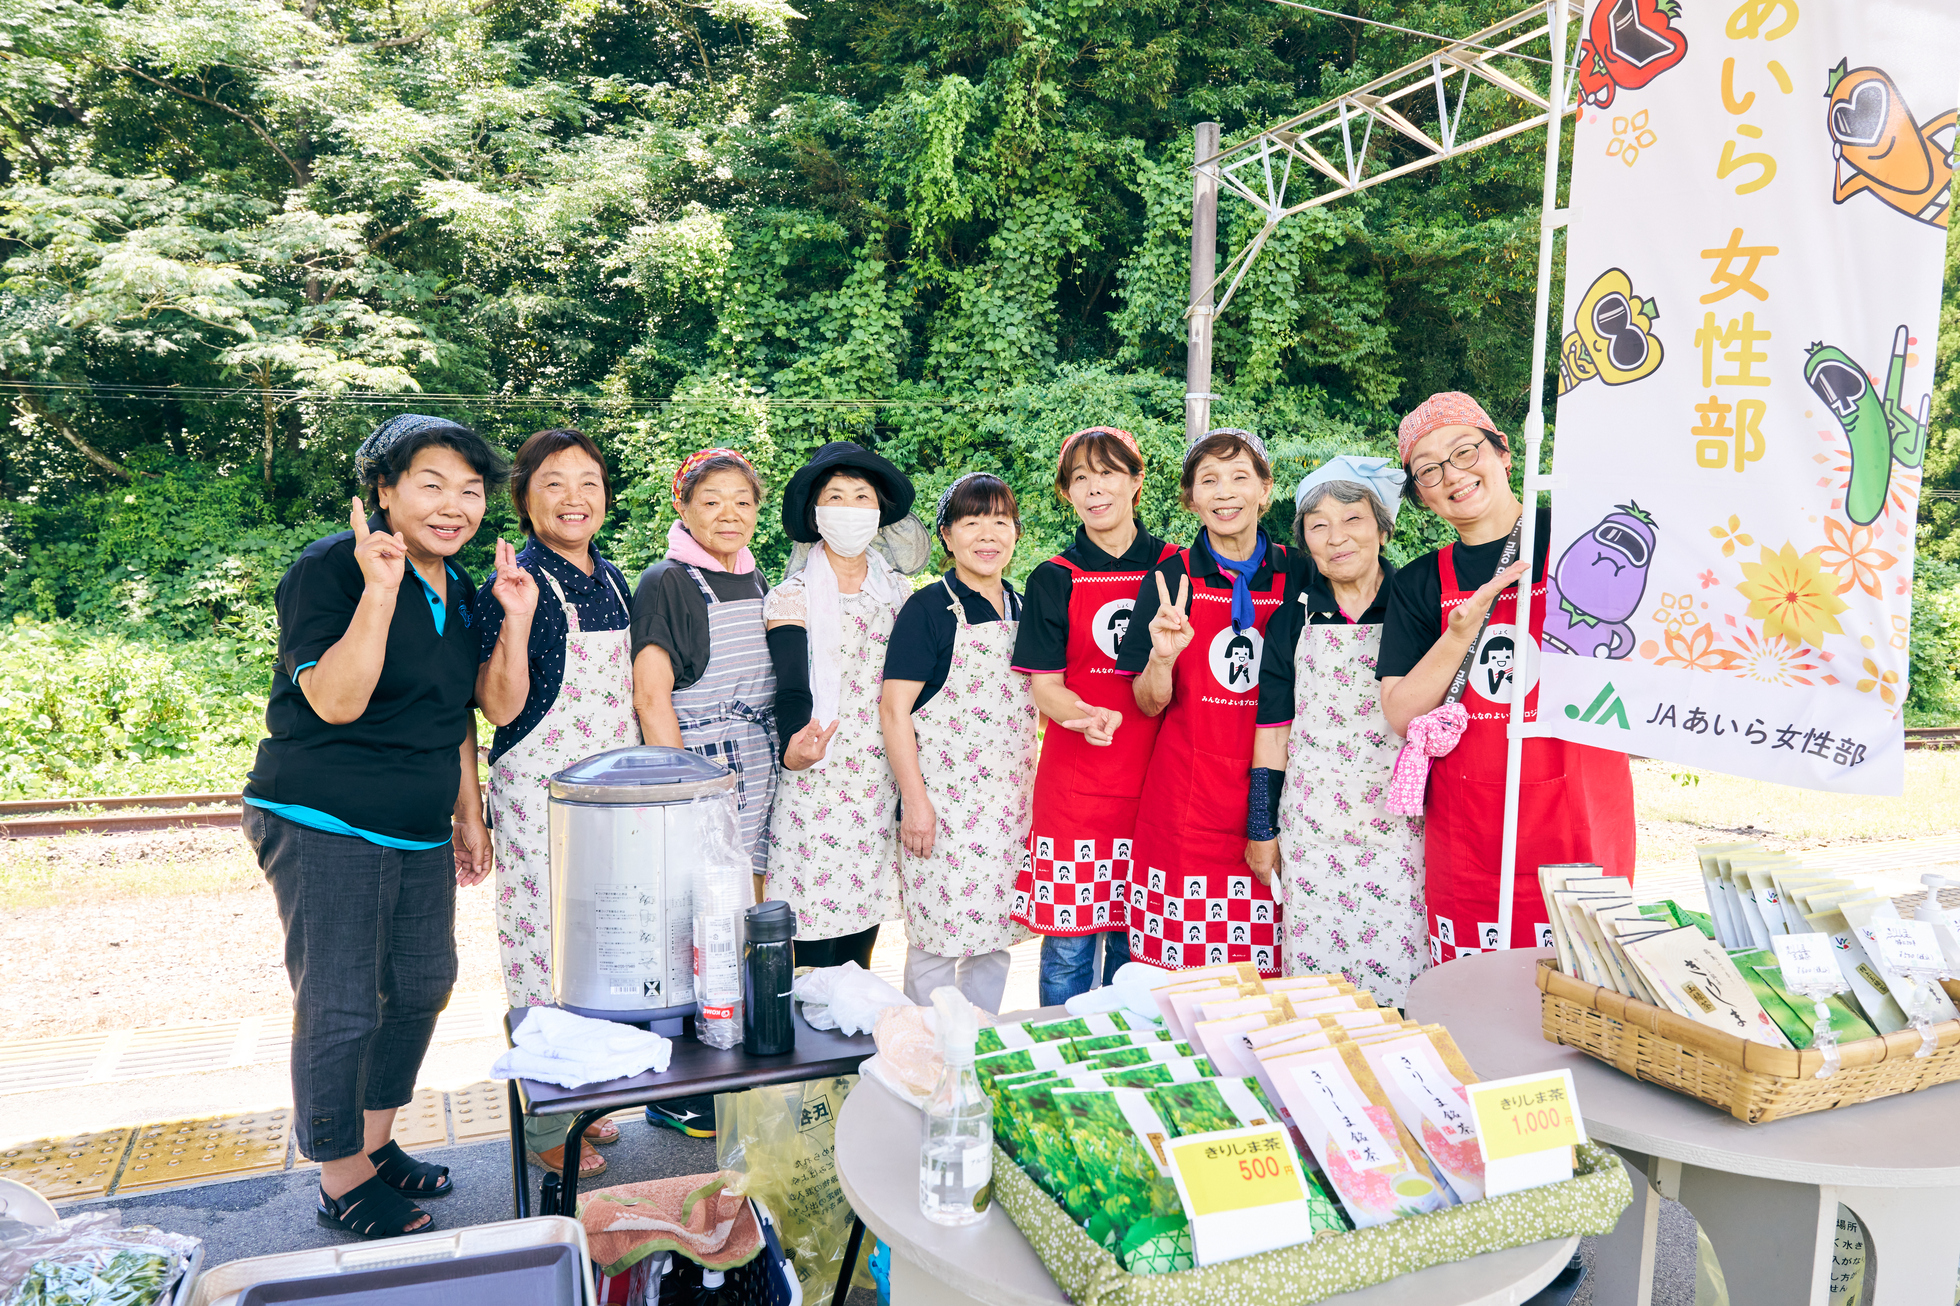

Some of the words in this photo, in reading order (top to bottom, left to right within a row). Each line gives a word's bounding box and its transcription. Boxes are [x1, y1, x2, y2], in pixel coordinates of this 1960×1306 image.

[1501, 541, 1516, 564] niko
[1450, 670, 1466, 694] niko
[1646, 702, 1867, 768] JAあいら女性部
[1500, 1088, 1565, 1111] きりしま茶
[1205, 1137, 1281, 1159] きりしま茶
